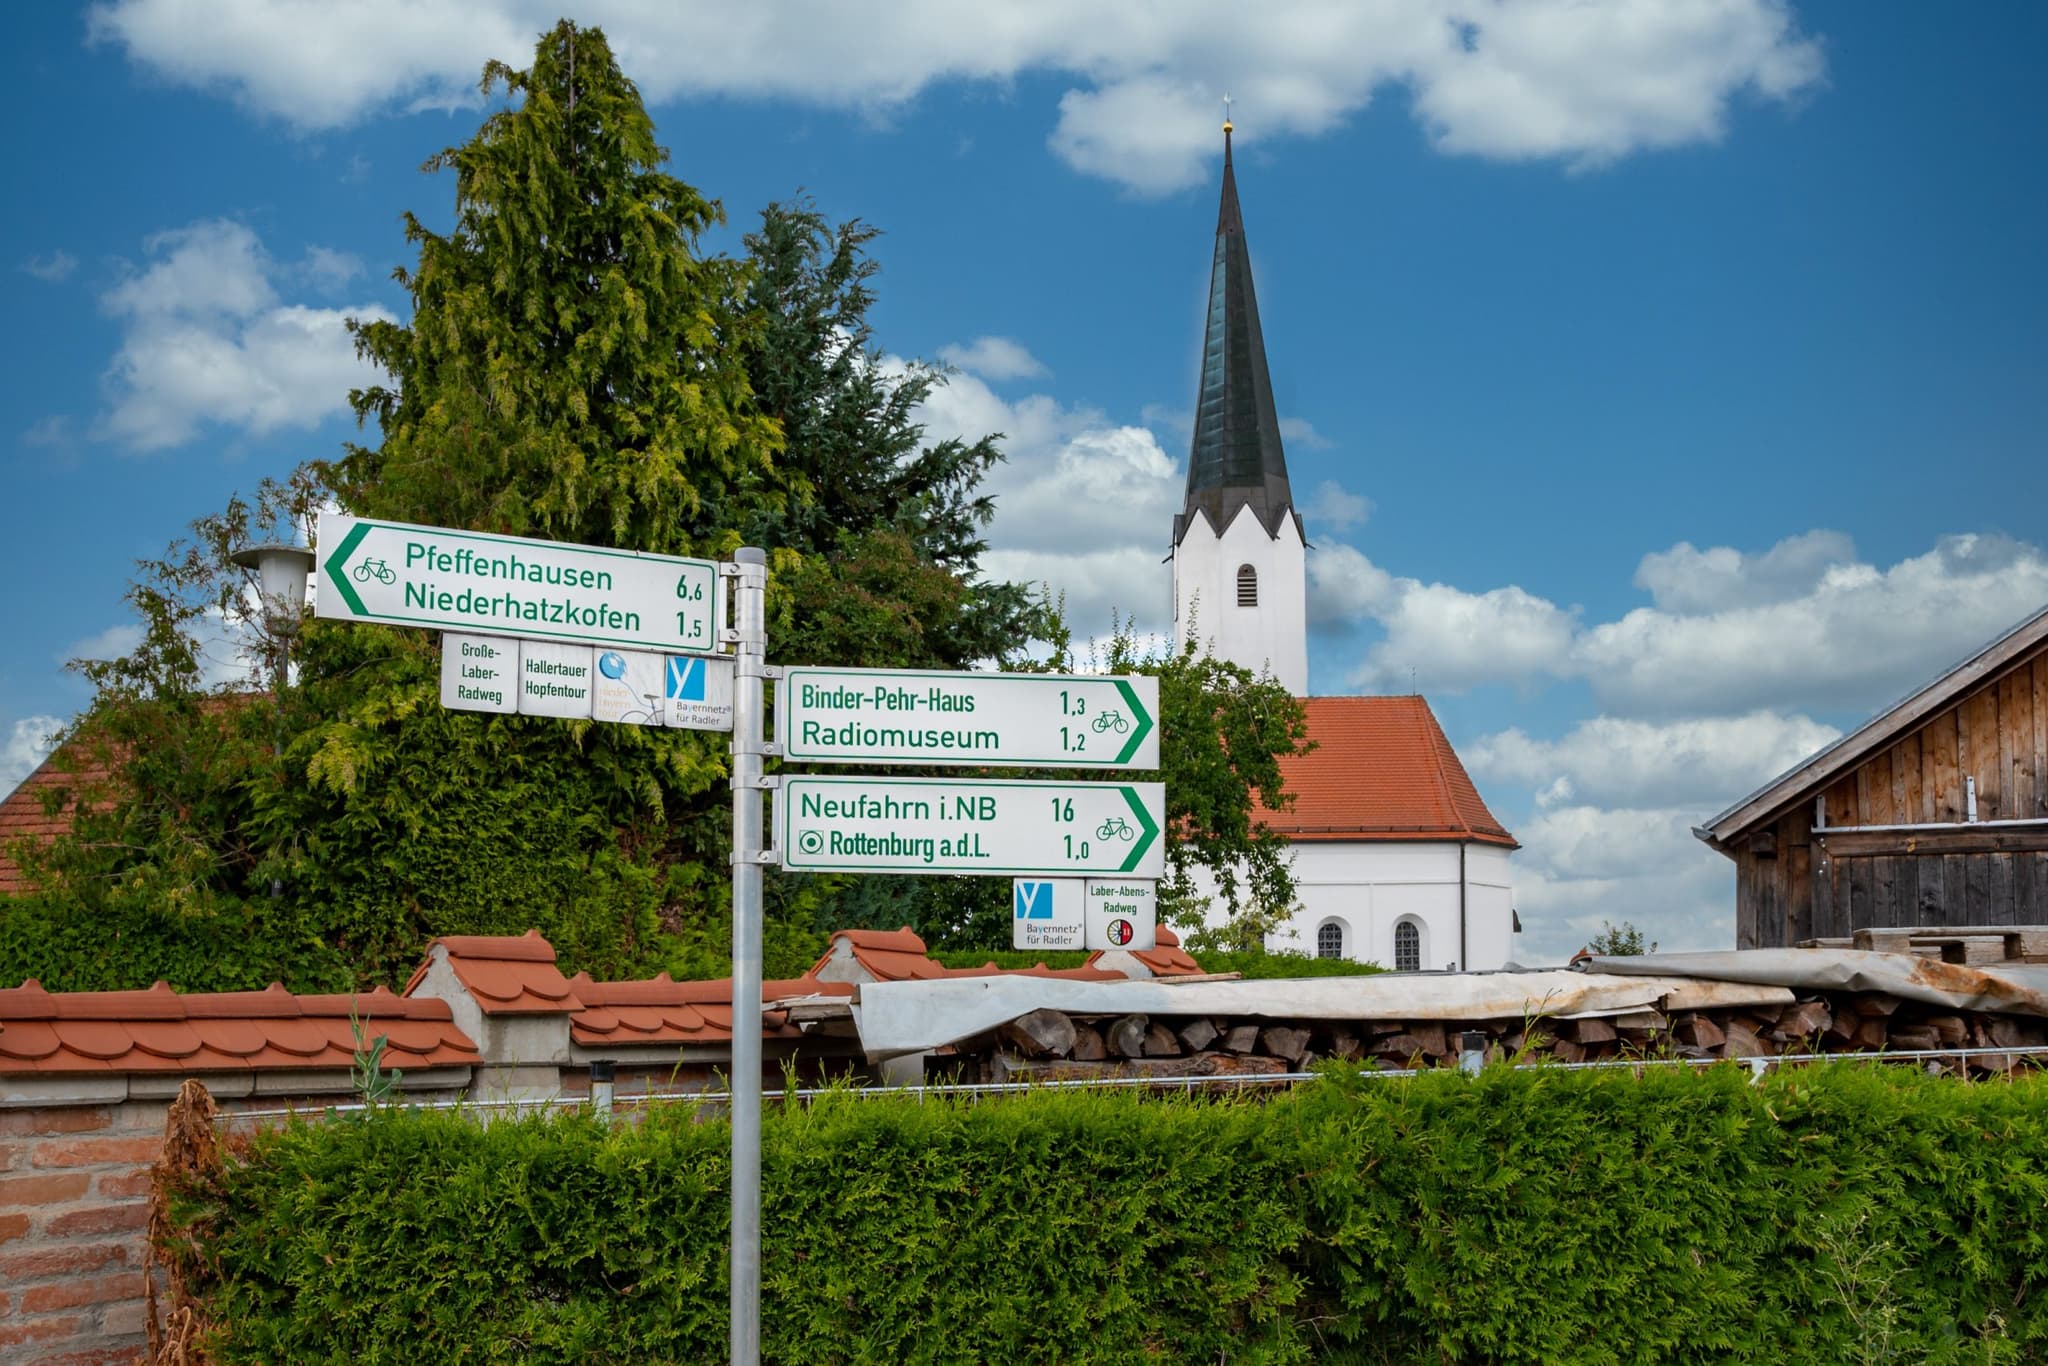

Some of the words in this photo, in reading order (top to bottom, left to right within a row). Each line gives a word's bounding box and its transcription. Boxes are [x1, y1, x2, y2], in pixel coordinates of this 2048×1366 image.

[405, 541, 613, 592] Pfeffenhausen
[676, 574, 703, 602] 6,6
[405, 581, 641, 632] Niederhatzkofen
[676, 610, 702, 639] 1,5
[461, 642, 501, 659] Große-
[462, 663, 500, 680] Laber-
[526, 658, 588, 678] Hallertauer
[458, 685, 503, 706] Radweg
[525, 680, 587, 699] Hopfentour
[801, 683, 975, 713] Binder-Pehr-Haus
[1059, 690, 1086, 717] 1,3
[676, 712, 689, 723] für
[691, 715, 721, 726] Radler
[801, 720, 1000, 750] Radiomuseum
[1059, 726, 1086, 753] 1,2
[801, 792, 930, 821] Neufahrn
[939, 794, 997, 822] i.NB
[1051, 797, 1075, 822] 16
[829, 830, 935, 863] Rottenburg
[939, 832, 991, 859] a.d.L.
[1063, 834, 1090, 860] 1,0
[1090, 885, 1151, 897] Laber-Abens-
[1103, 902, 1137, 915] Radweg
[1026, 935, 1041, 945] für
[1043, 935, 1073, 945] Radler
